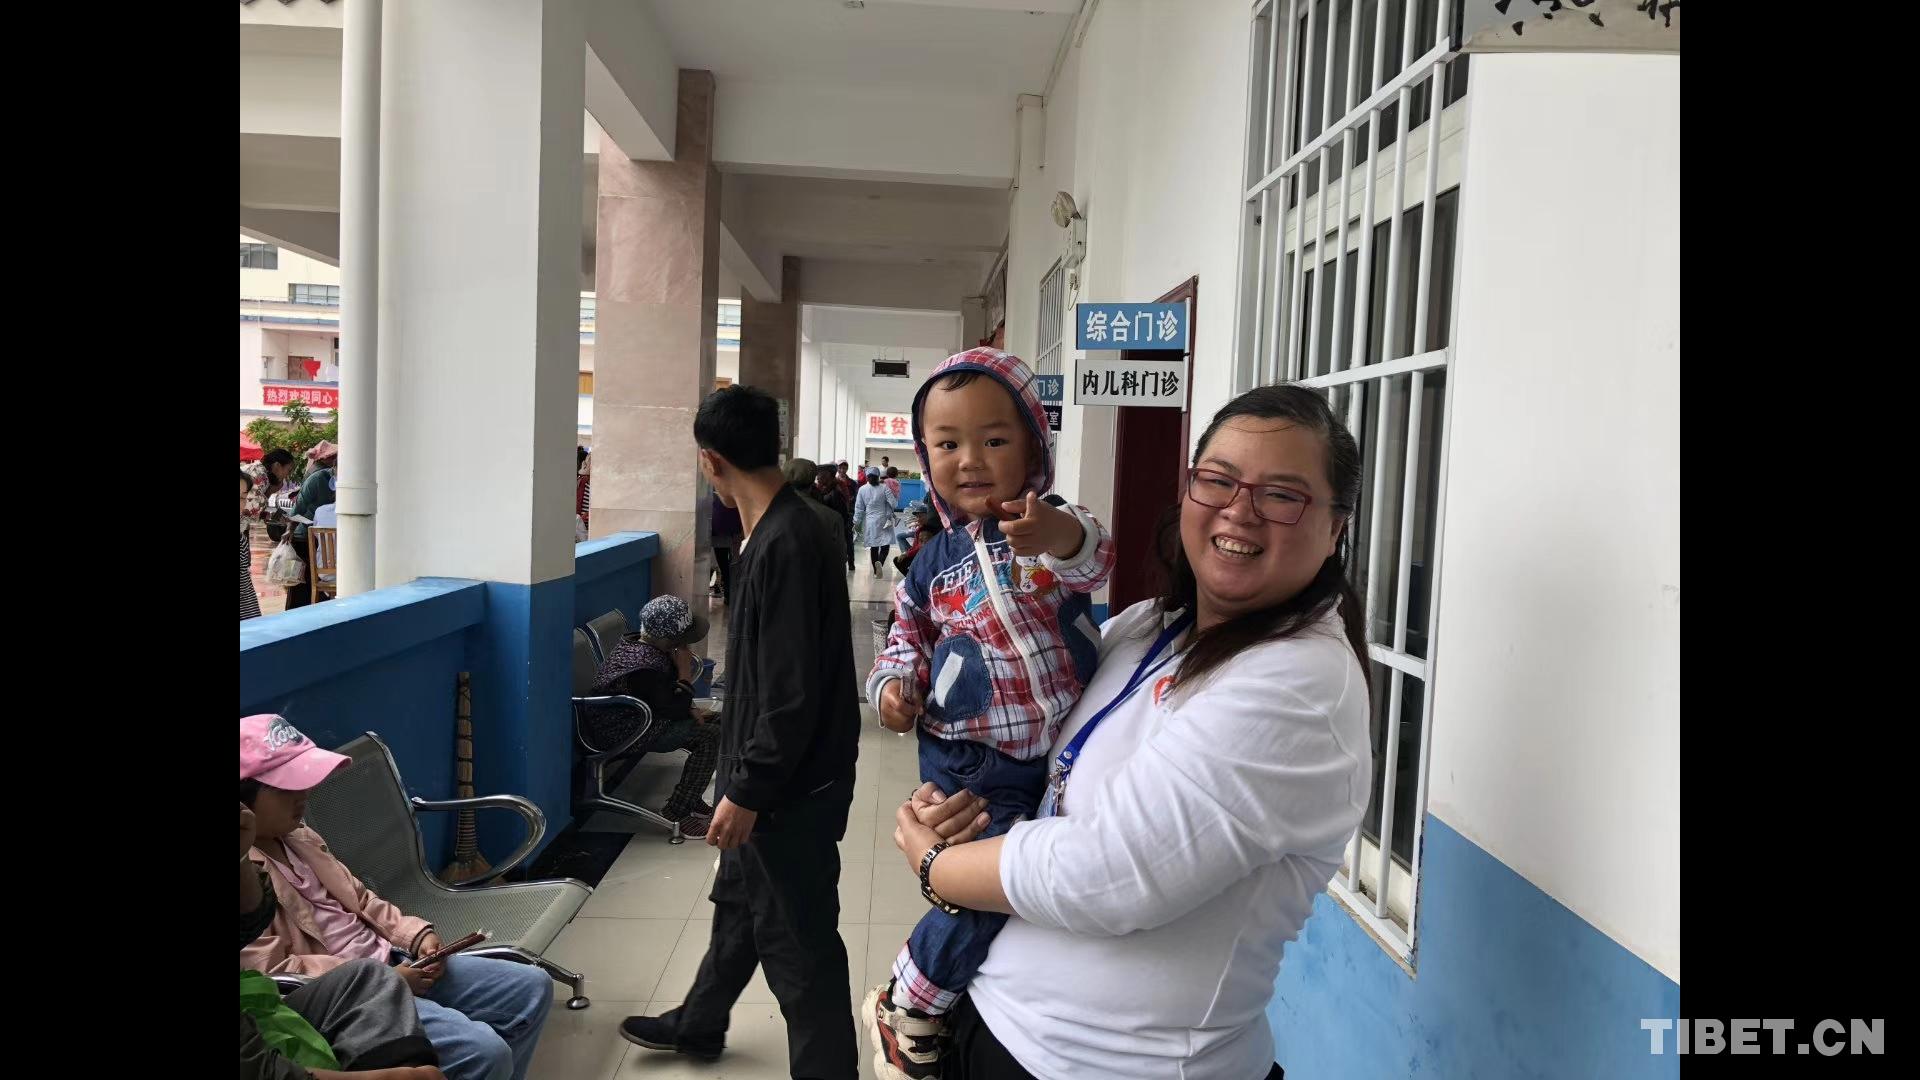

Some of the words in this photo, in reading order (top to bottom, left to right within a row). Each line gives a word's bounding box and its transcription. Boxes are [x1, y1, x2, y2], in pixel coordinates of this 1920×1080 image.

[1086, 310, 1179, 342] 综合门诊
[1082, 369, 1179, 397] 内儿科门诊
[869, 415, 908, 434] 脱贫
